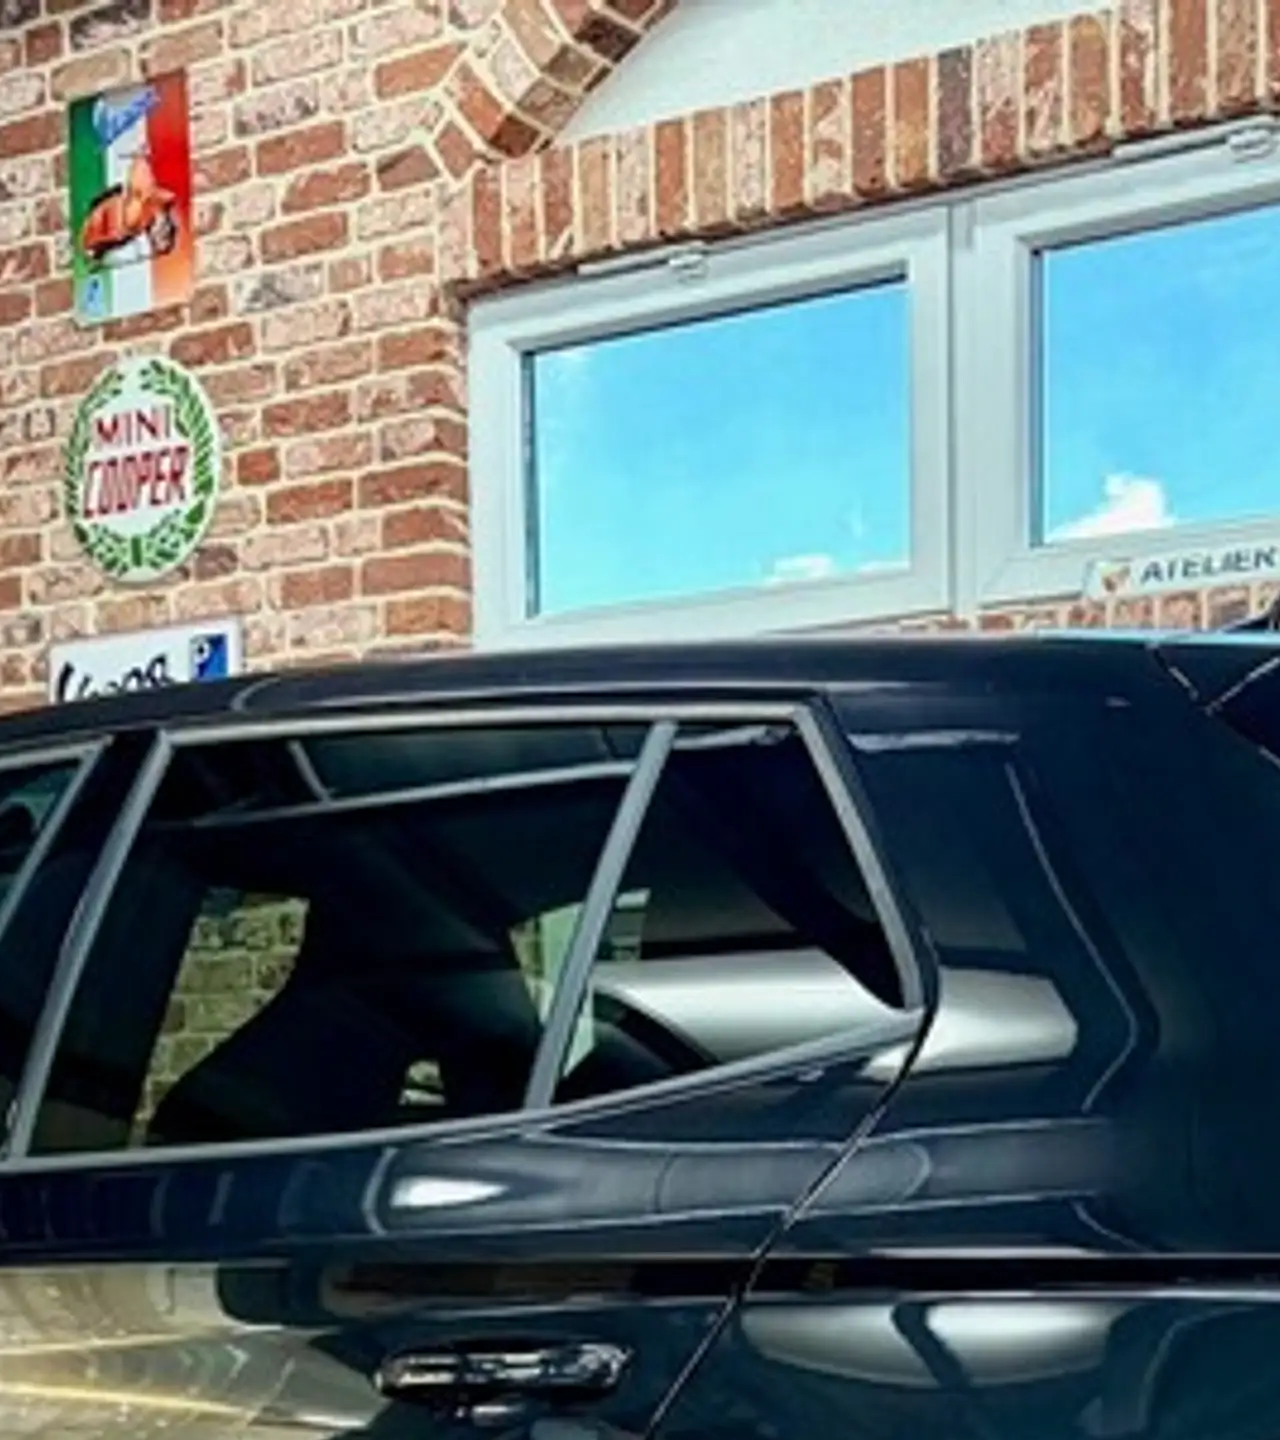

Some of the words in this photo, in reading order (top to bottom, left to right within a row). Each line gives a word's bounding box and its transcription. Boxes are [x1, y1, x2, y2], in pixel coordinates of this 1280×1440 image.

[92, 403, 172, 447] MINI
[83, 445, 189, 519] COOPER
[1139, 545, 1277, 584] ATELIER
